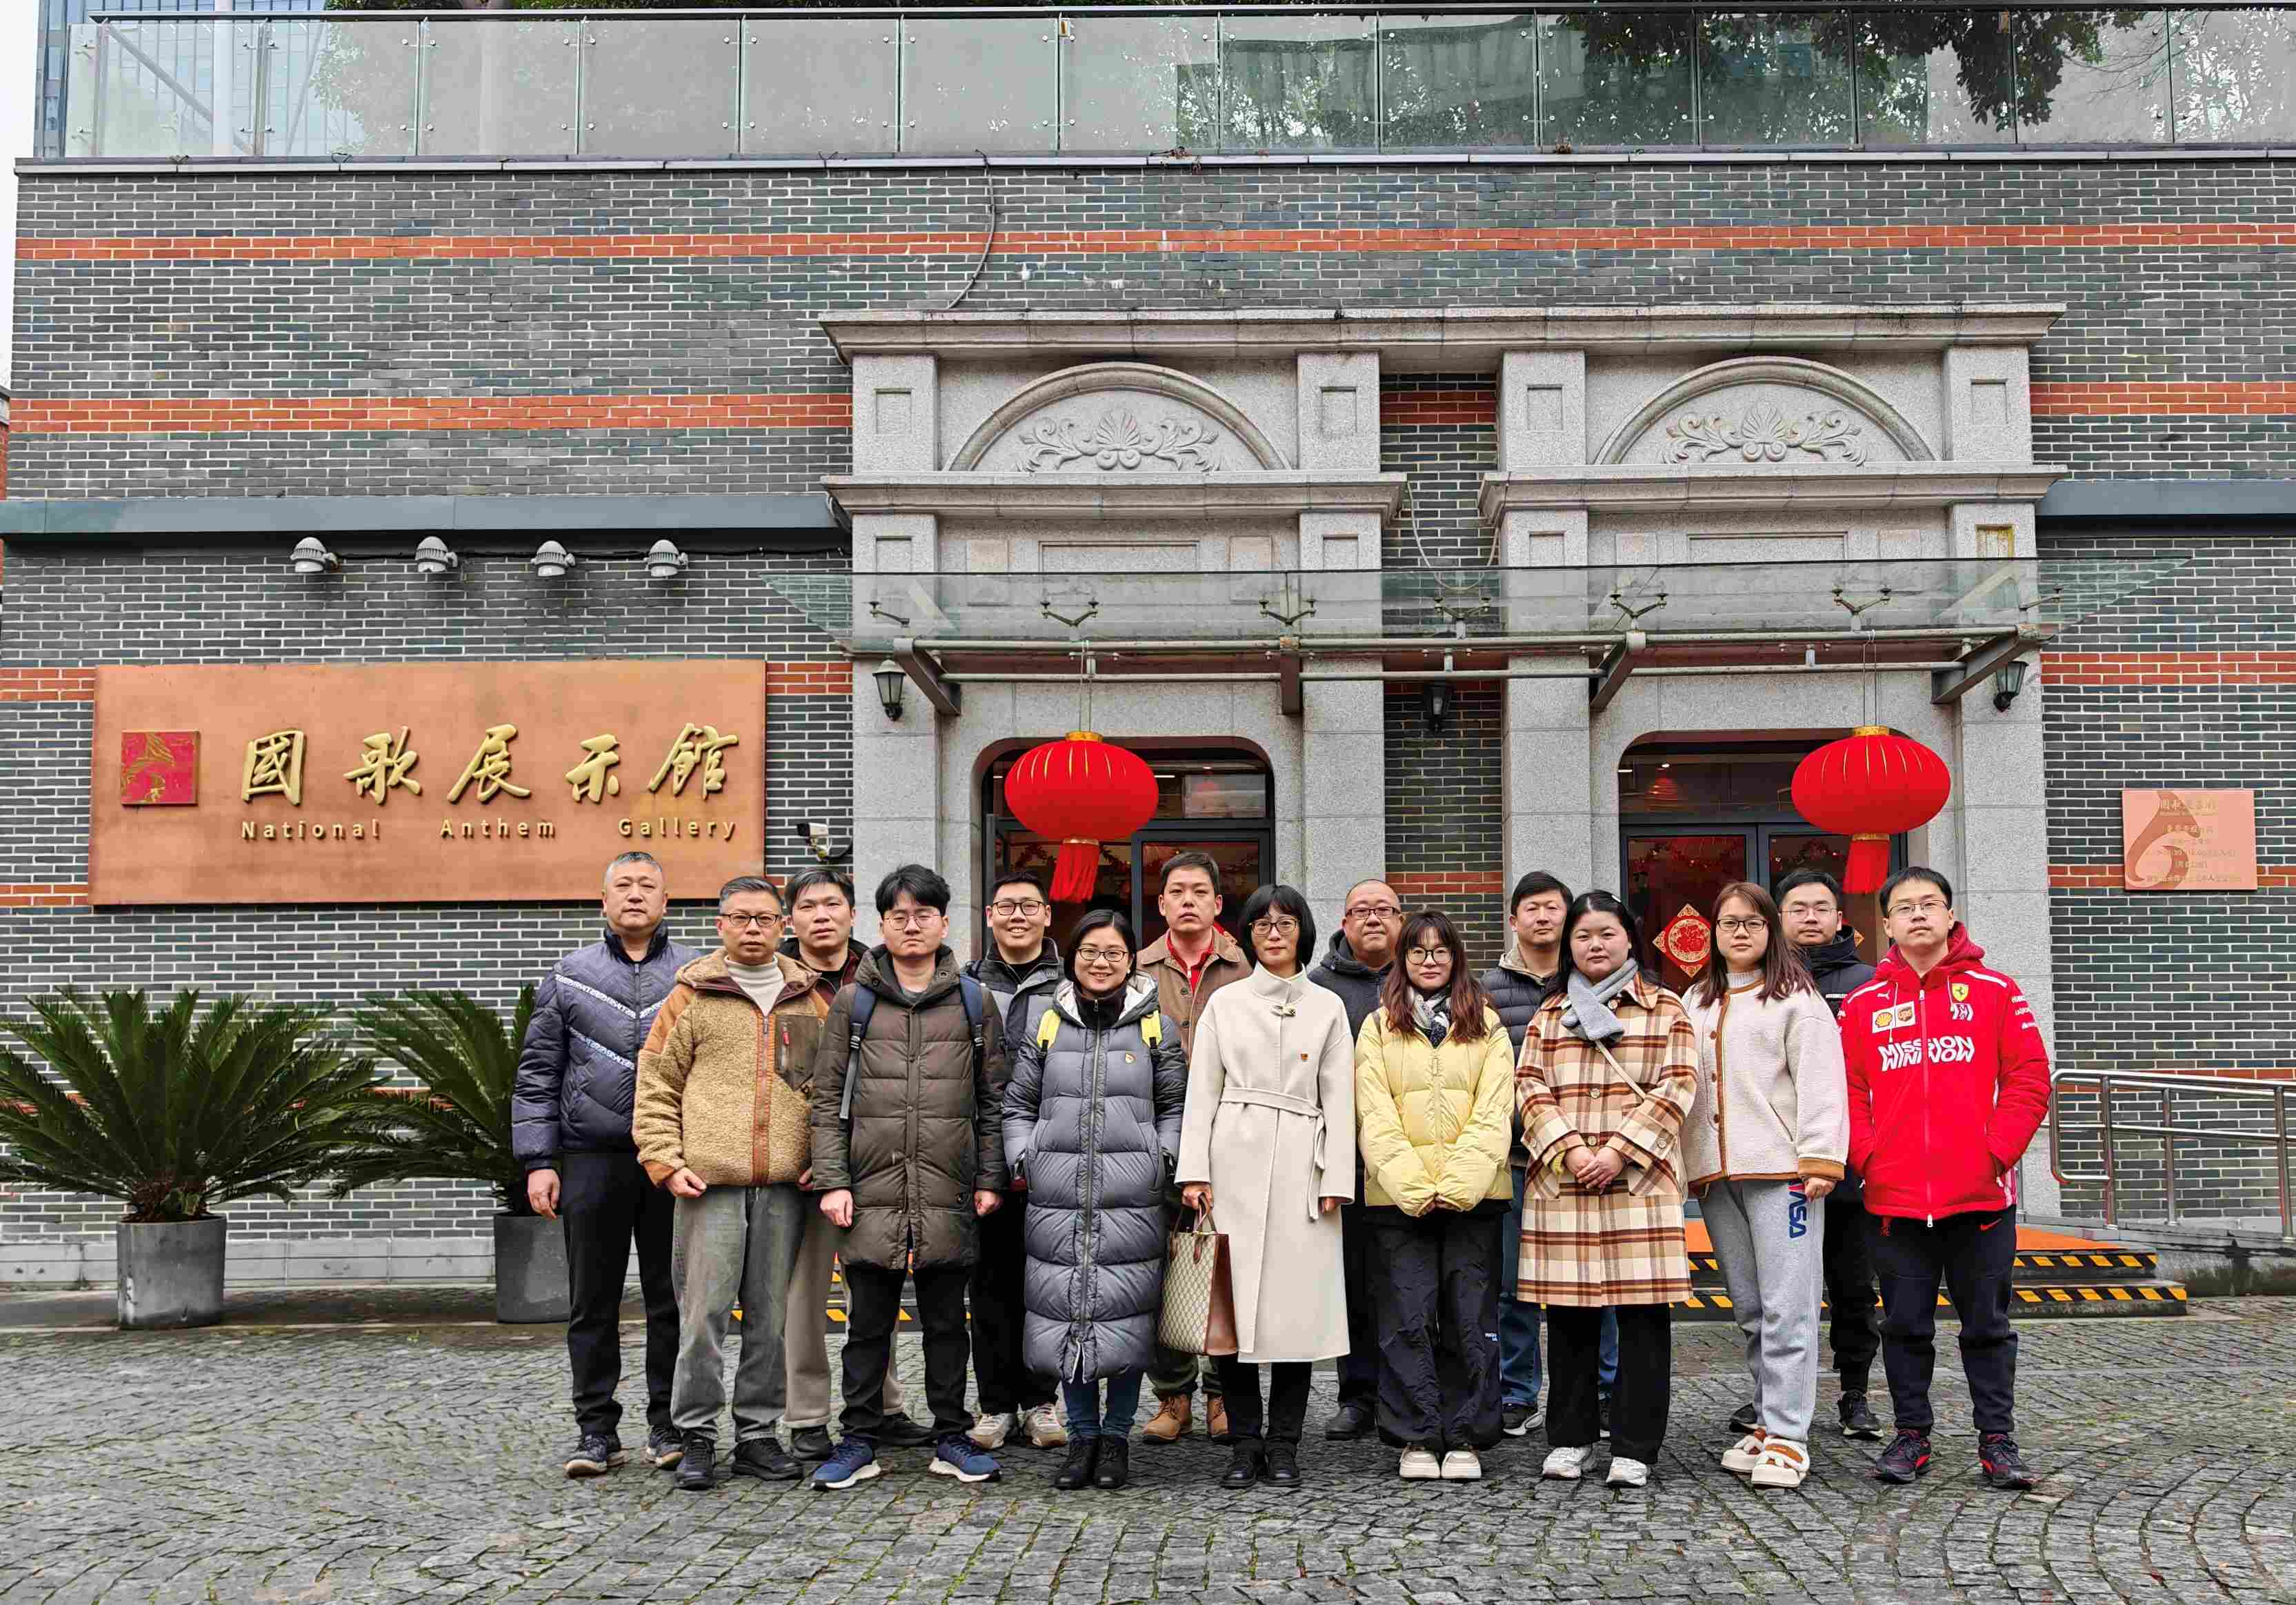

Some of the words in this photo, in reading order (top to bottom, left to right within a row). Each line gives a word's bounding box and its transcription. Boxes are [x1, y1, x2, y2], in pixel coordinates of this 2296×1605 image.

[242, 723, 739, 806] 國歌展示館
[241, 818, 379, 839] National
[440, 818, 555, 839] Anthem
[618, 817, 736, 841] Gallery
